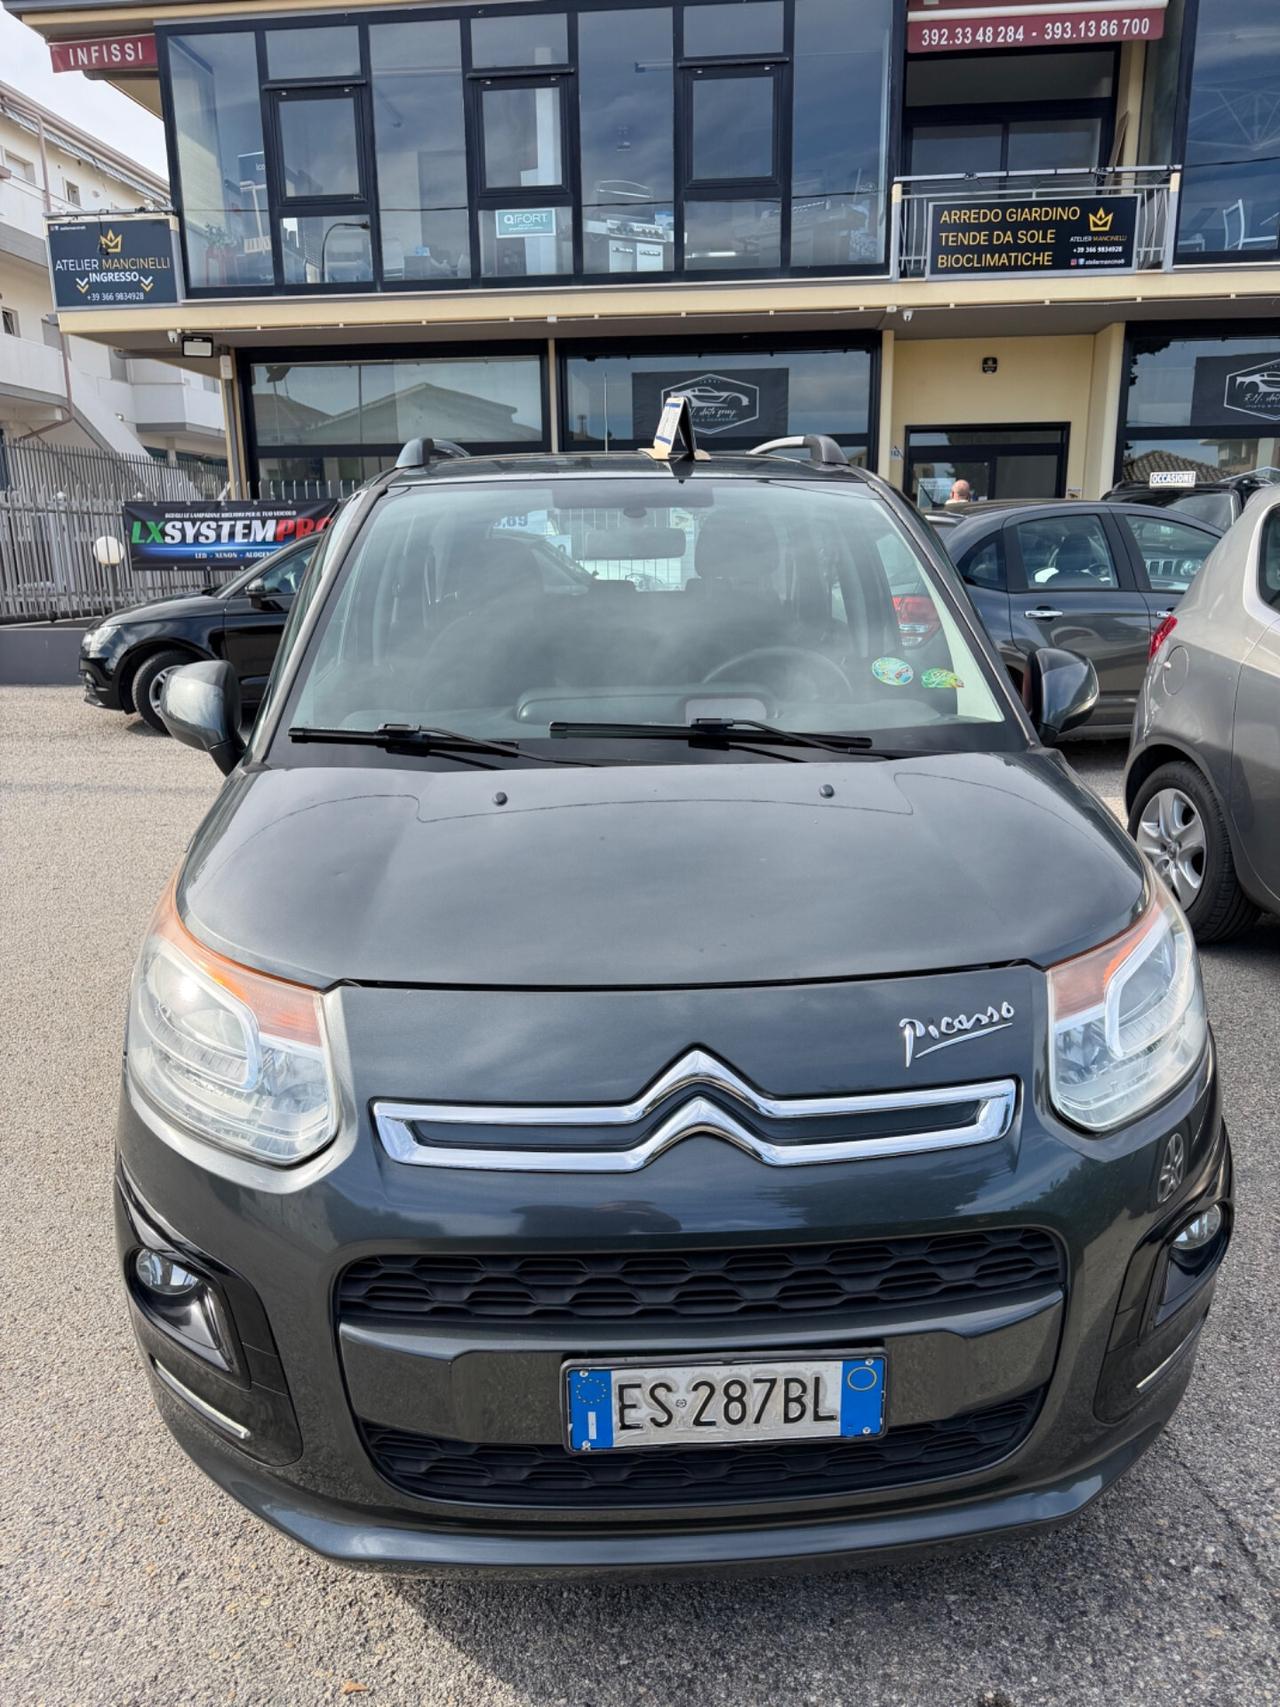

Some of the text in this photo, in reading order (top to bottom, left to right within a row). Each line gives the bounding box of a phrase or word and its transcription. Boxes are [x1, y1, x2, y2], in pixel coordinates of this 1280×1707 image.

[69, 41, 143, 66] INFISSI
[940, 206, 1080, 224] ARREDO GIARDINO
[939, 229, 1056, 246] TENDE DA SOLE
[55, 256, 171, 271] ATELIER MANCINELLI
[937, 251, 1054, 268] BIOCLIMATICHE
[89, 271, 139, 283] INGRESSO
[87, 291, 145, 301] +39 366 9834928
[1151, 473, 1195, 484] OCCASIONE
